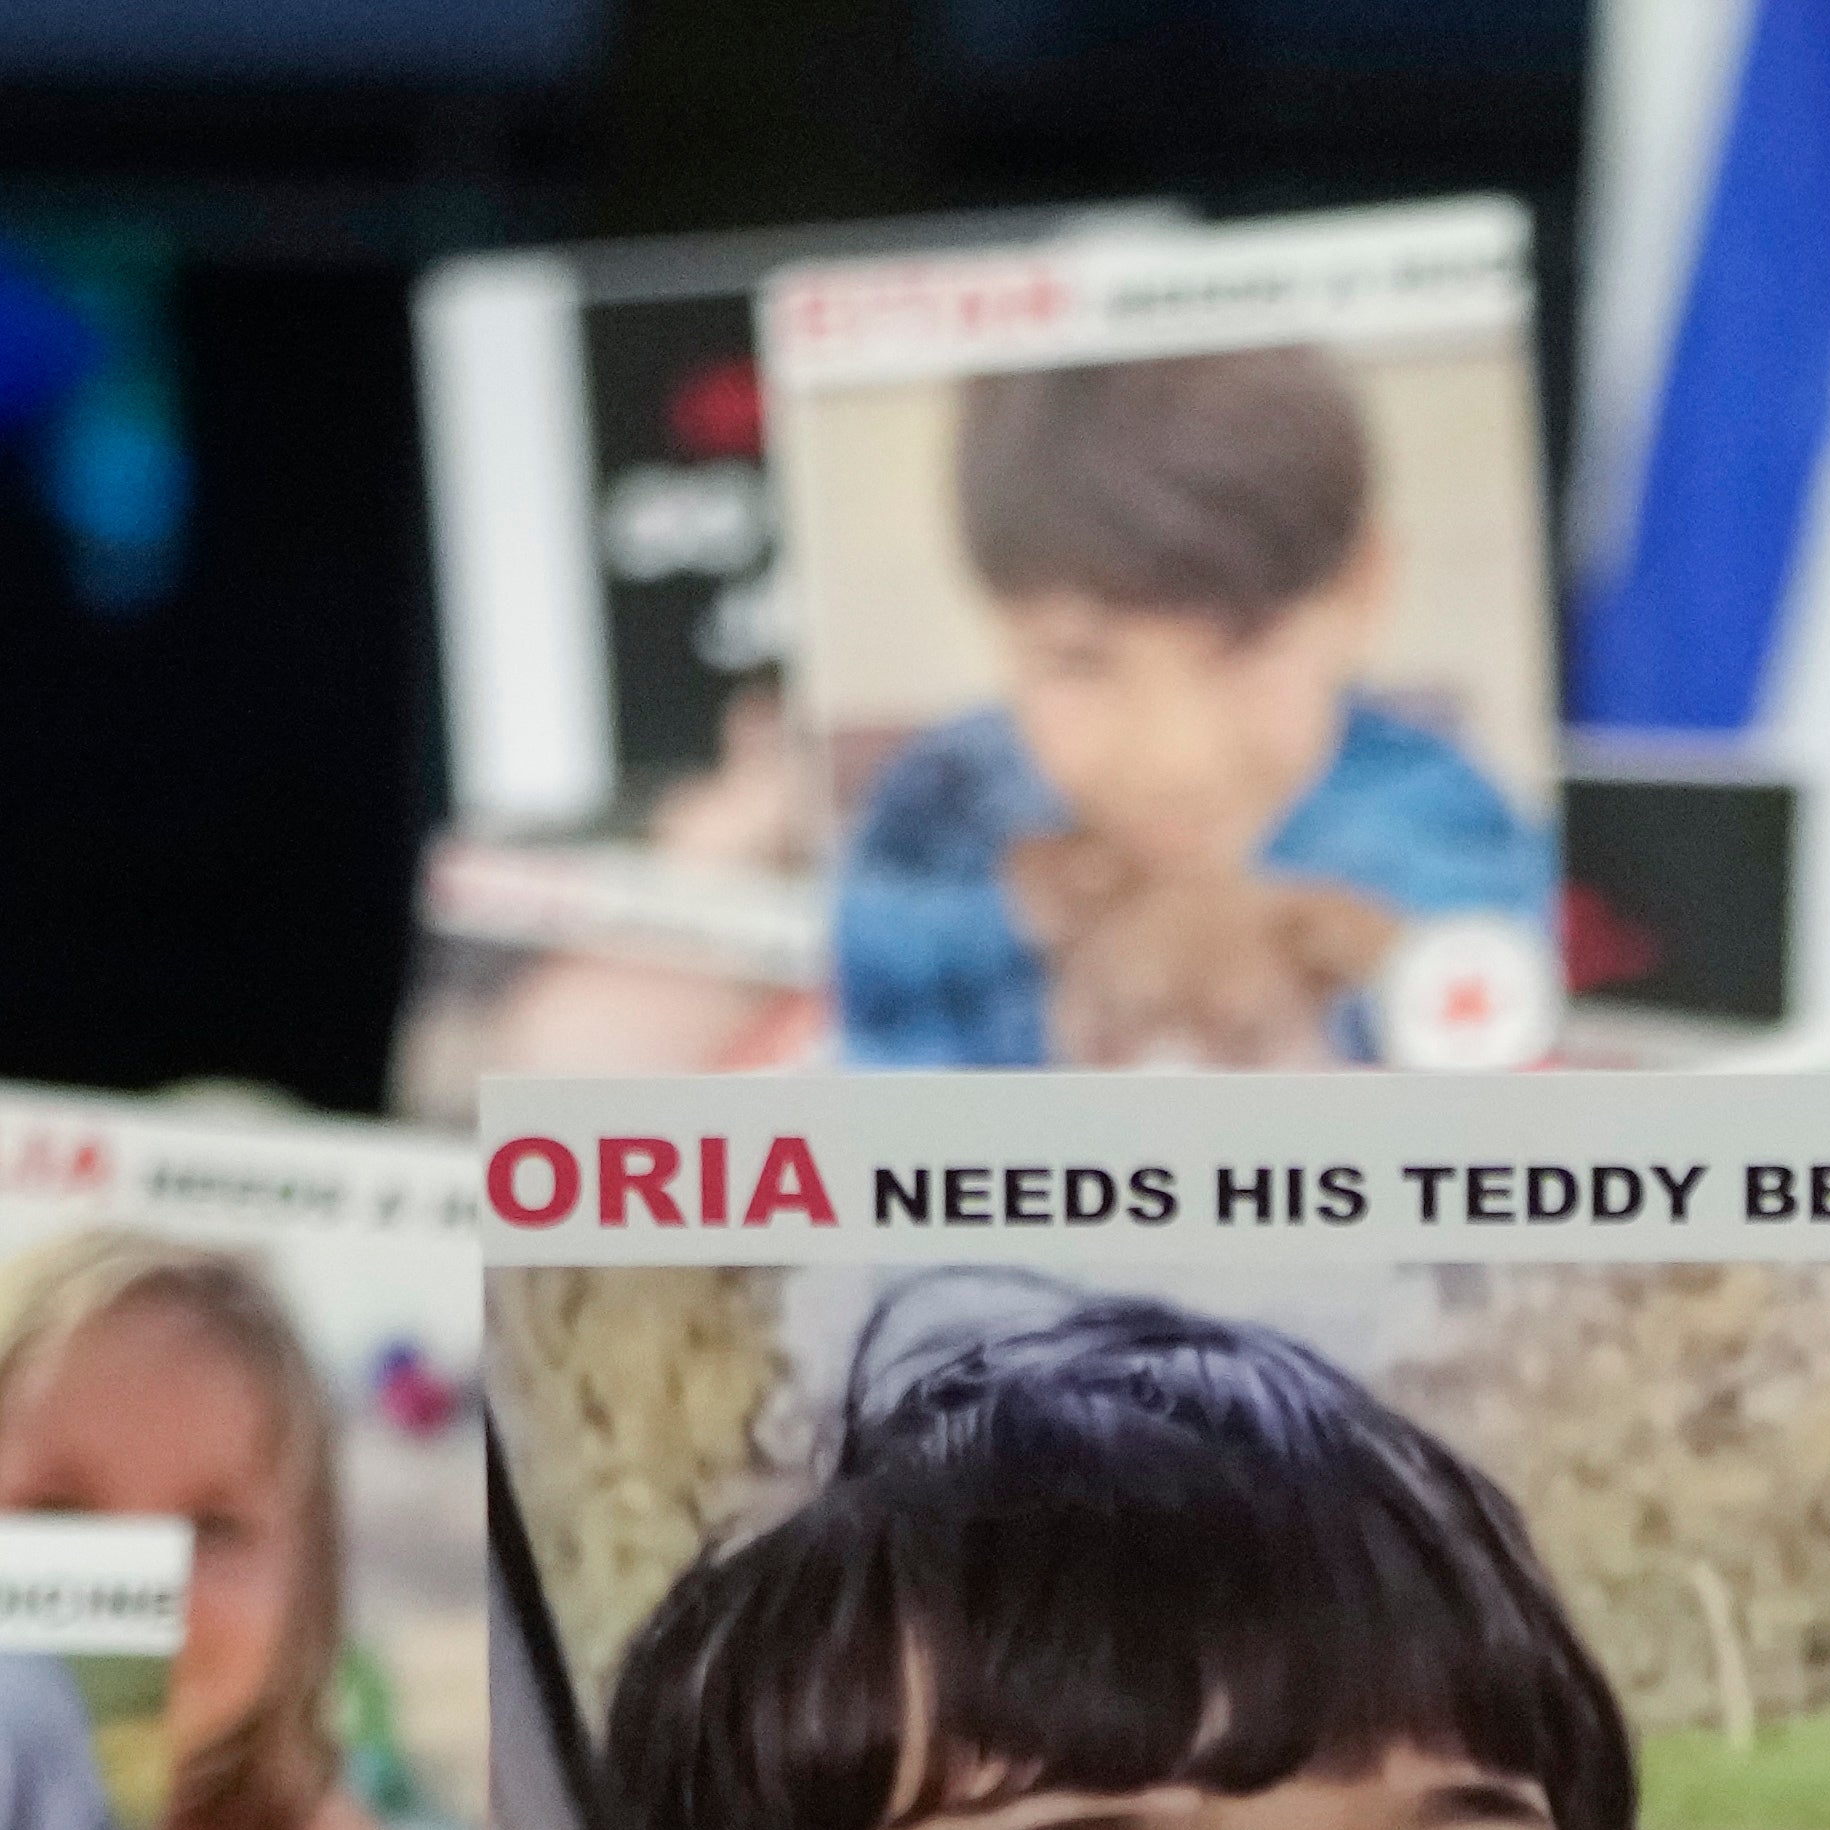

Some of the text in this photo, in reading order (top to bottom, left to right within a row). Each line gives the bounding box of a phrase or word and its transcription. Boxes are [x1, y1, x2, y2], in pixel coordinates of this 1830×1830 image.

[485, 1135, 838, 1228] ORIA
[873, 1167, 1178, 1225] NEEDS
[1216, 1166, 1368, 1224] HIS
[1402, 1165, 1706, 1223] TEDDY
